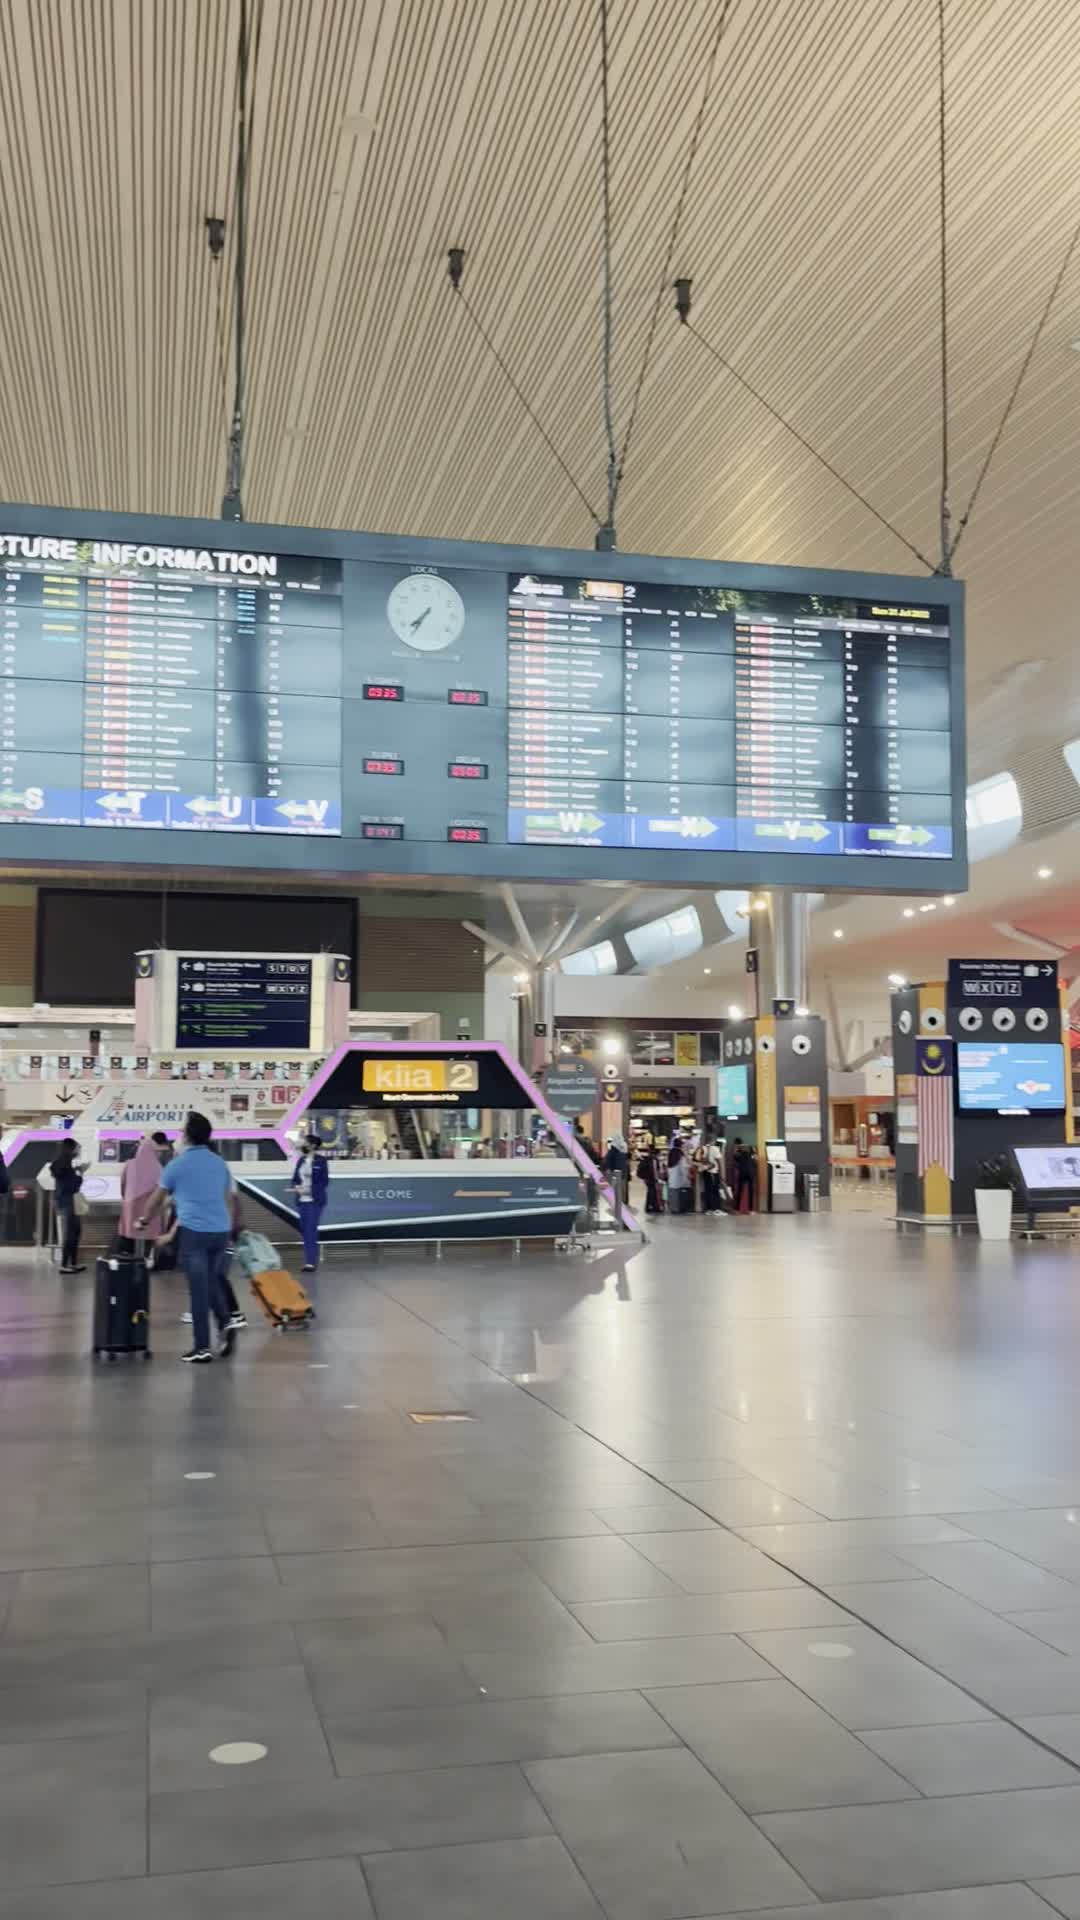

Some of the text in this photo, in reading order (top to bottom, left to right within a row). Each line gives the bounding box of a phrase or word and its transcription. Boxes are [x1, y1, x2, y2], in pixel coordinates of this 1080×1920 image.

[92, 542, 278, 577] INFORMATION
[24, 786, 44, 810] S
[124, 791, 147, 814] T
[220, 795, 242, 818] U
[308, 799, 329, 821] V
[559, 811, 584, 833] W
[783, 820, 801, 840] Y
[449, 1063, 473, 1088] 2
[122, 1110, 189, 1122] AIRPORT
[349, 1188, 413, 1199] WELCOME
